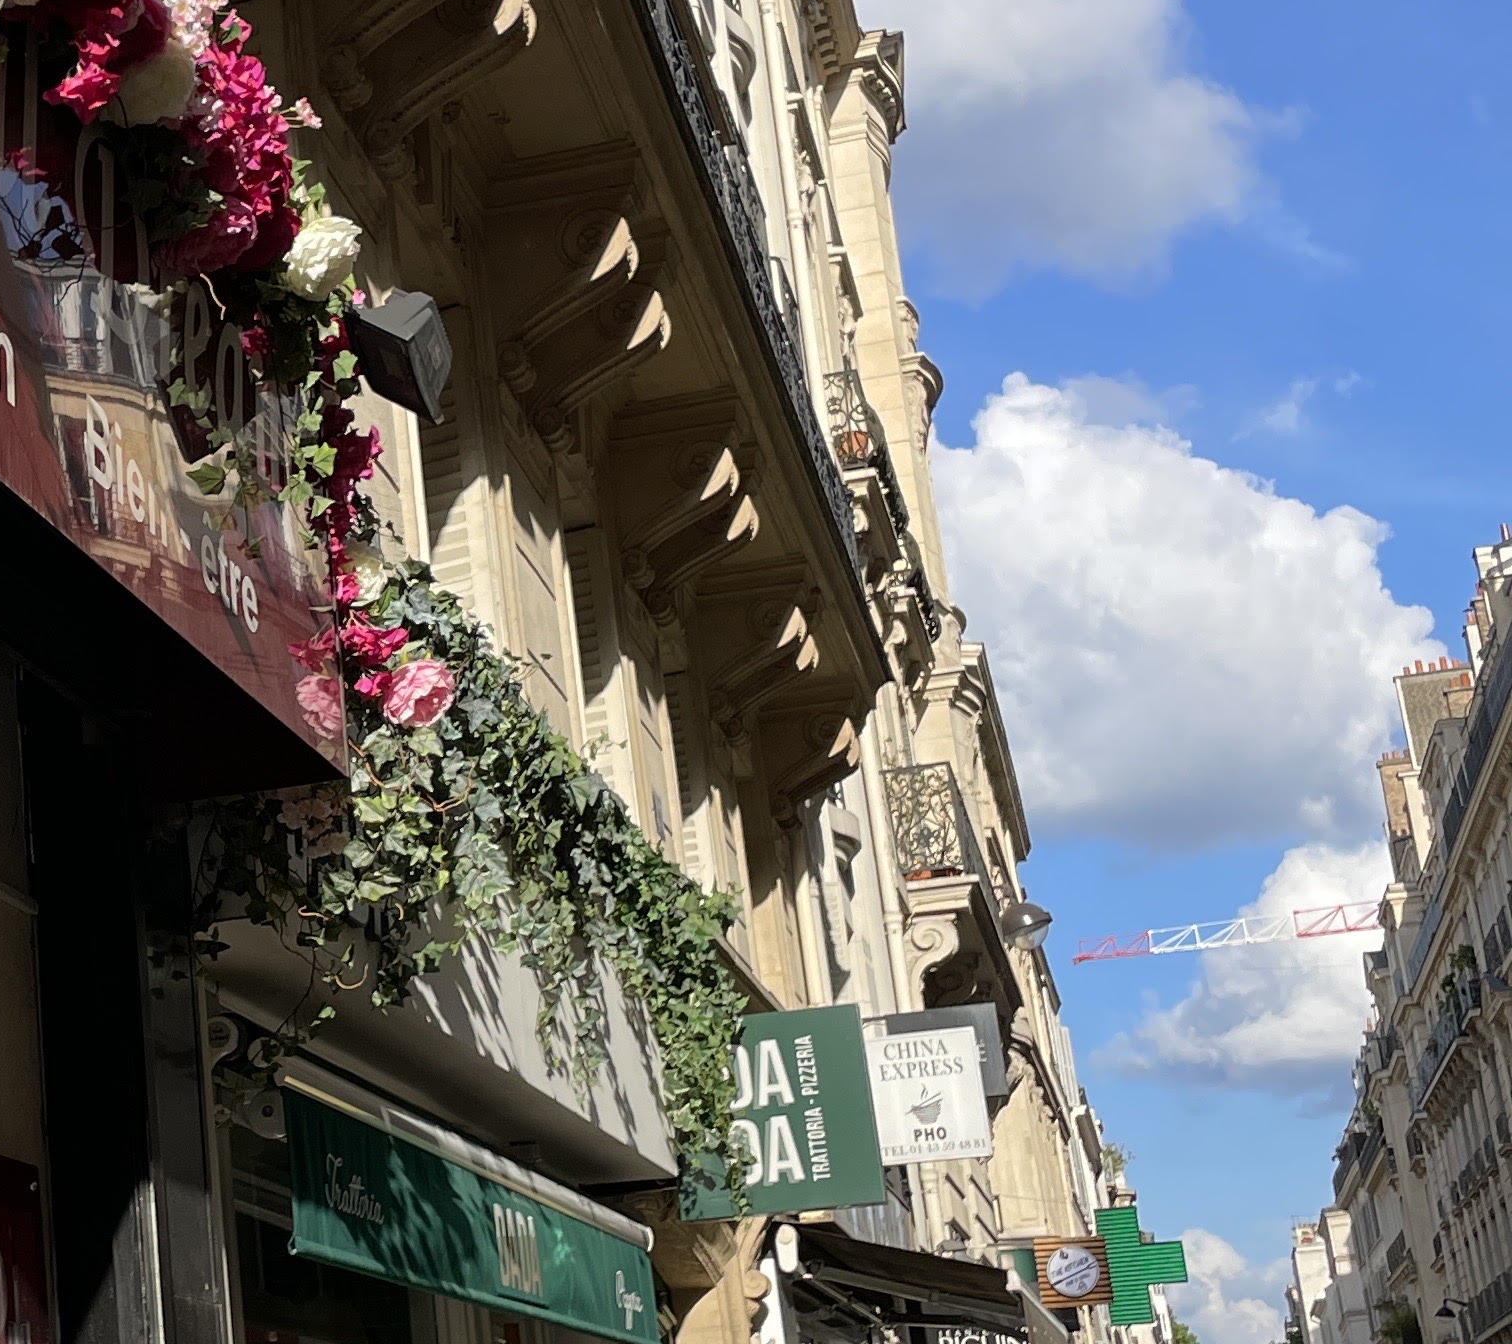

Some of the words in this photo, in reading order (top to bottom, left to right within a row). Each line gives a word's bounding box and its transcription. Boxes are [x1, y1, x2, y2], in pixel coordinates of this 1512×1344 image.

[794, 1034, 820, 1097] PIZZERIA
[880, 1056, 964, 1082] EXPRESS
[883, 1038, 948, 1061] CHINA
[804, 1105, 831, 1182] TRATTORIA
[913, 1126, 948, 1142] PHO
[325, 1153, 386, 1226] Trattoria
[493, 1202, 543, 1297] DADA
